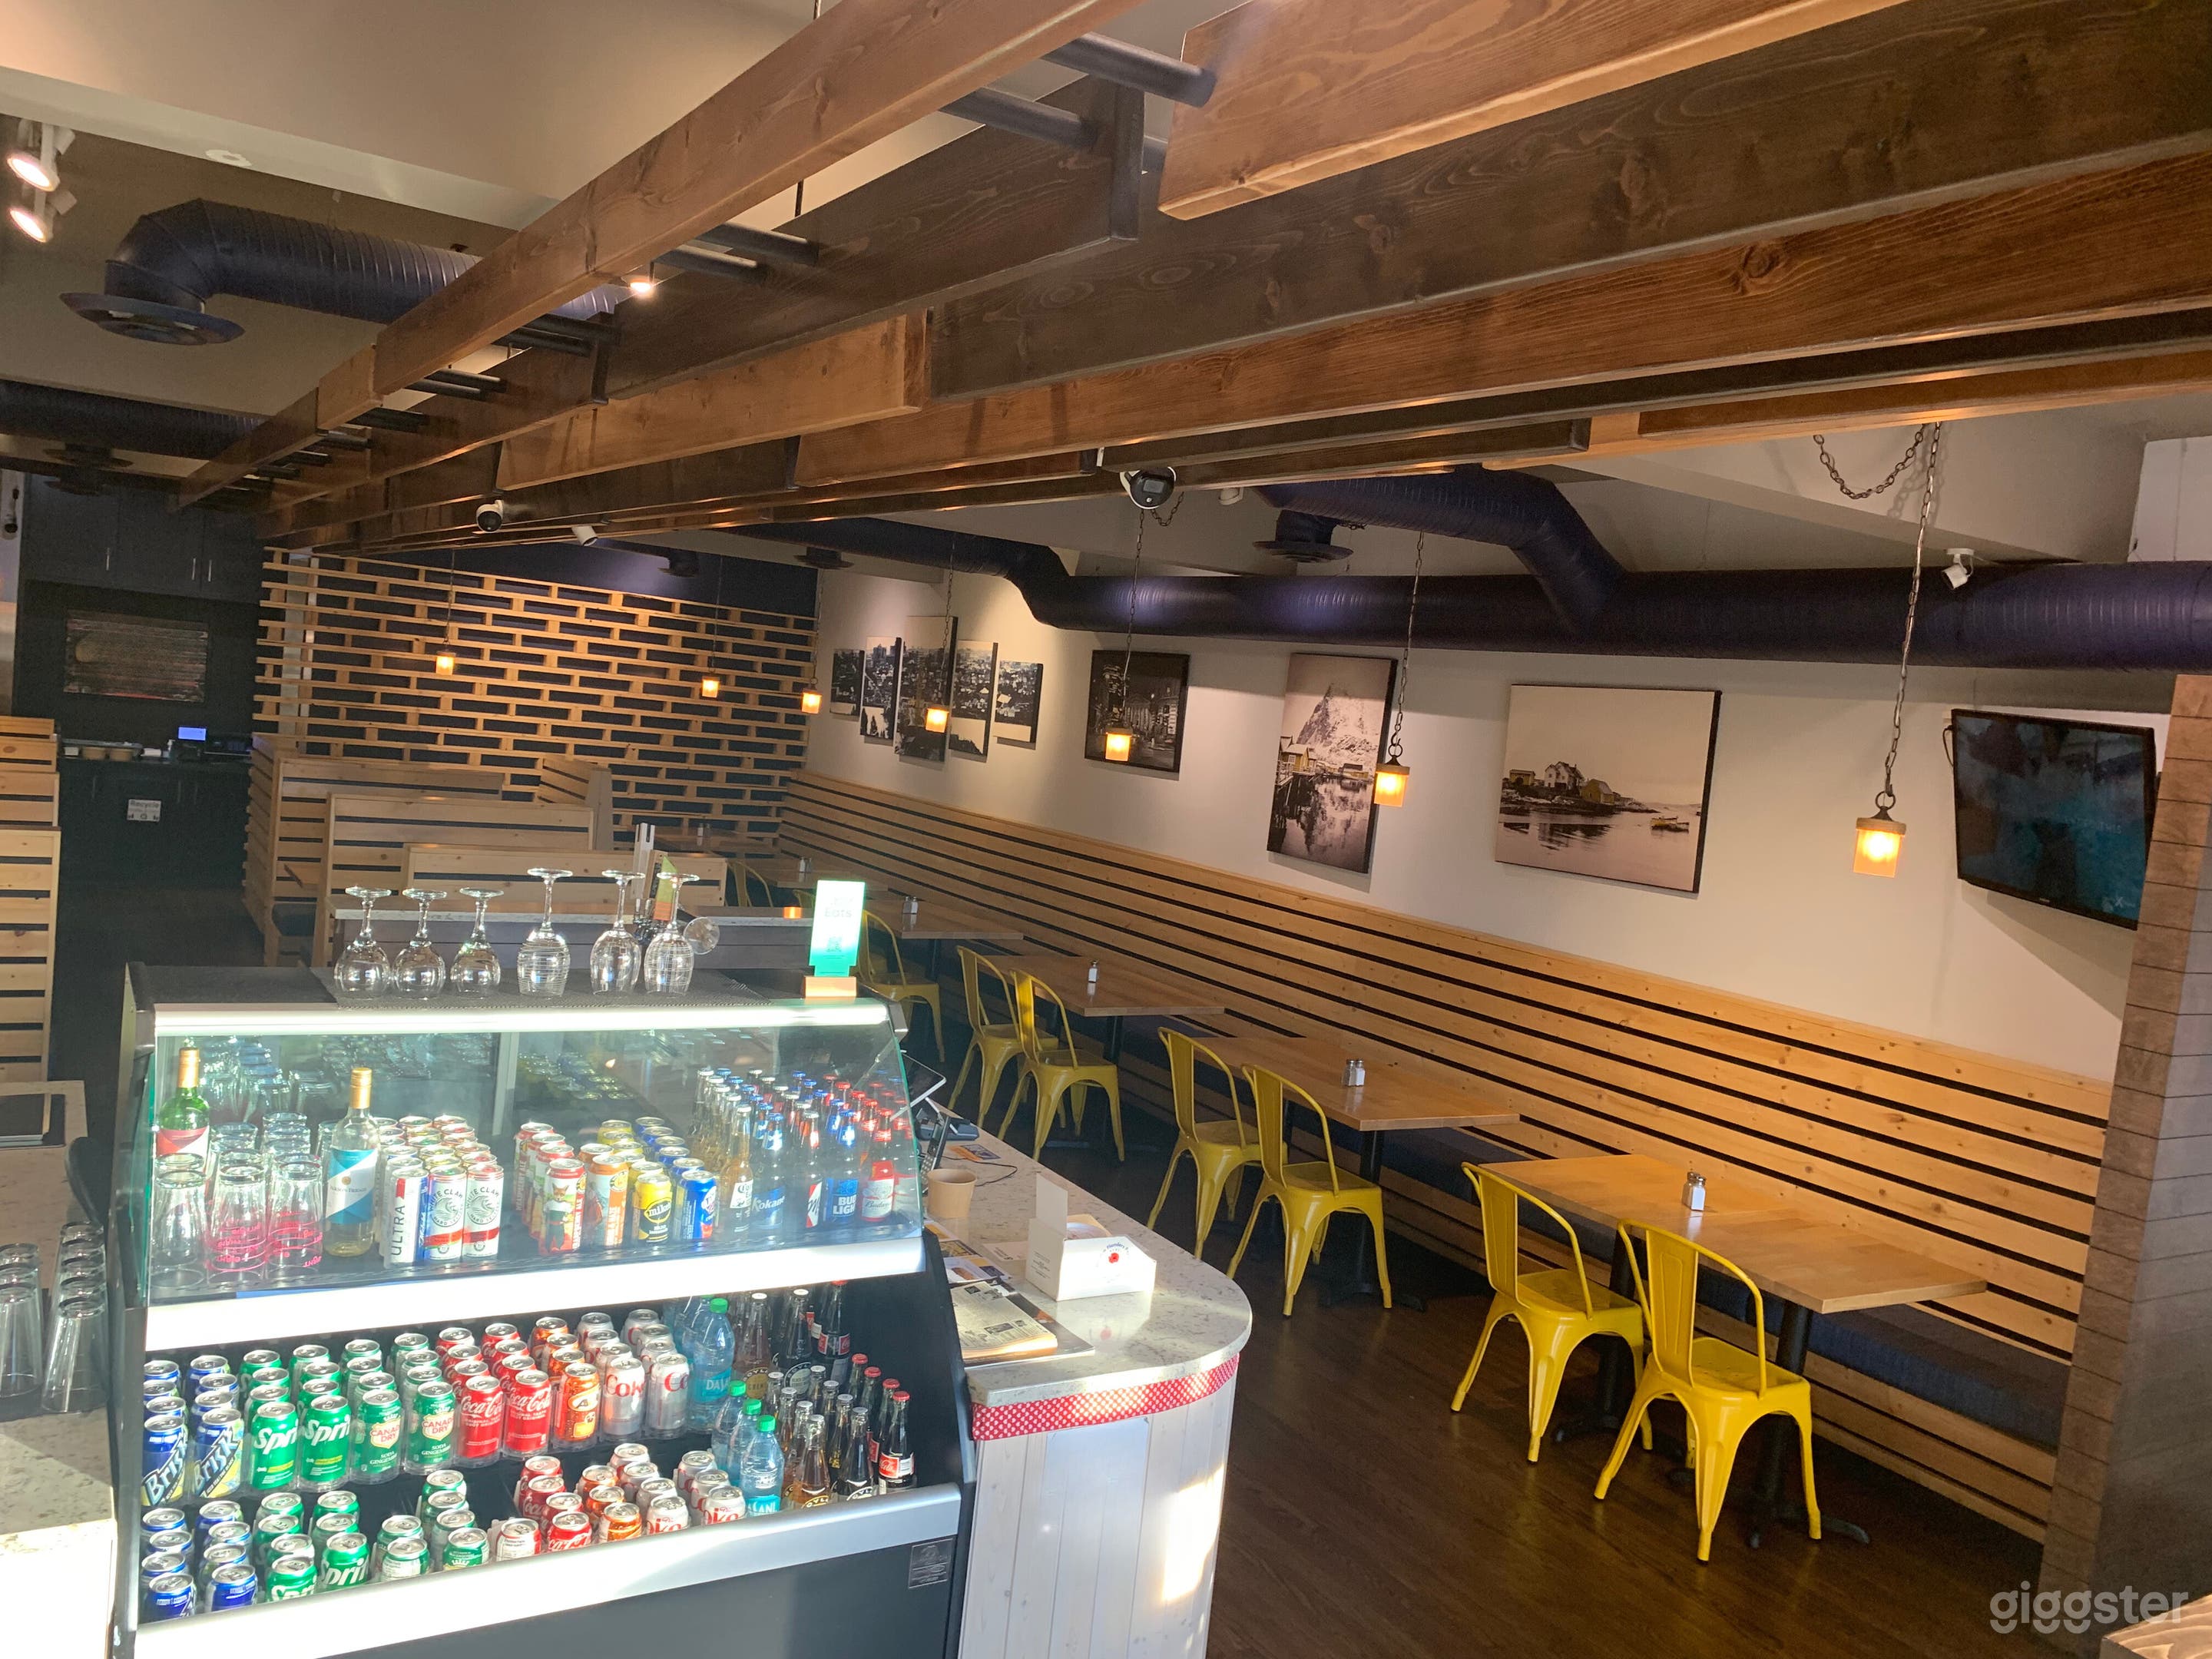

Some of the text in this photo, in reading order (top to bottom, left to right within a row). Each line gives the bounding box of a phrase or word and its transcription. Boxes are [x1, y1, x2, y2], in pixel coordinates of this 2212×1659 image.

[430, 1191, 442, 1211] WHITE
[465, 1188, 479, 1209] WHITE
[391, 1205, 406, 1256] ULTRA
[380, 1433, 396, 1442] DRY
[432, 1426, 448, 1434] DRY
[194, 1426, 240, 1495] Brisk
